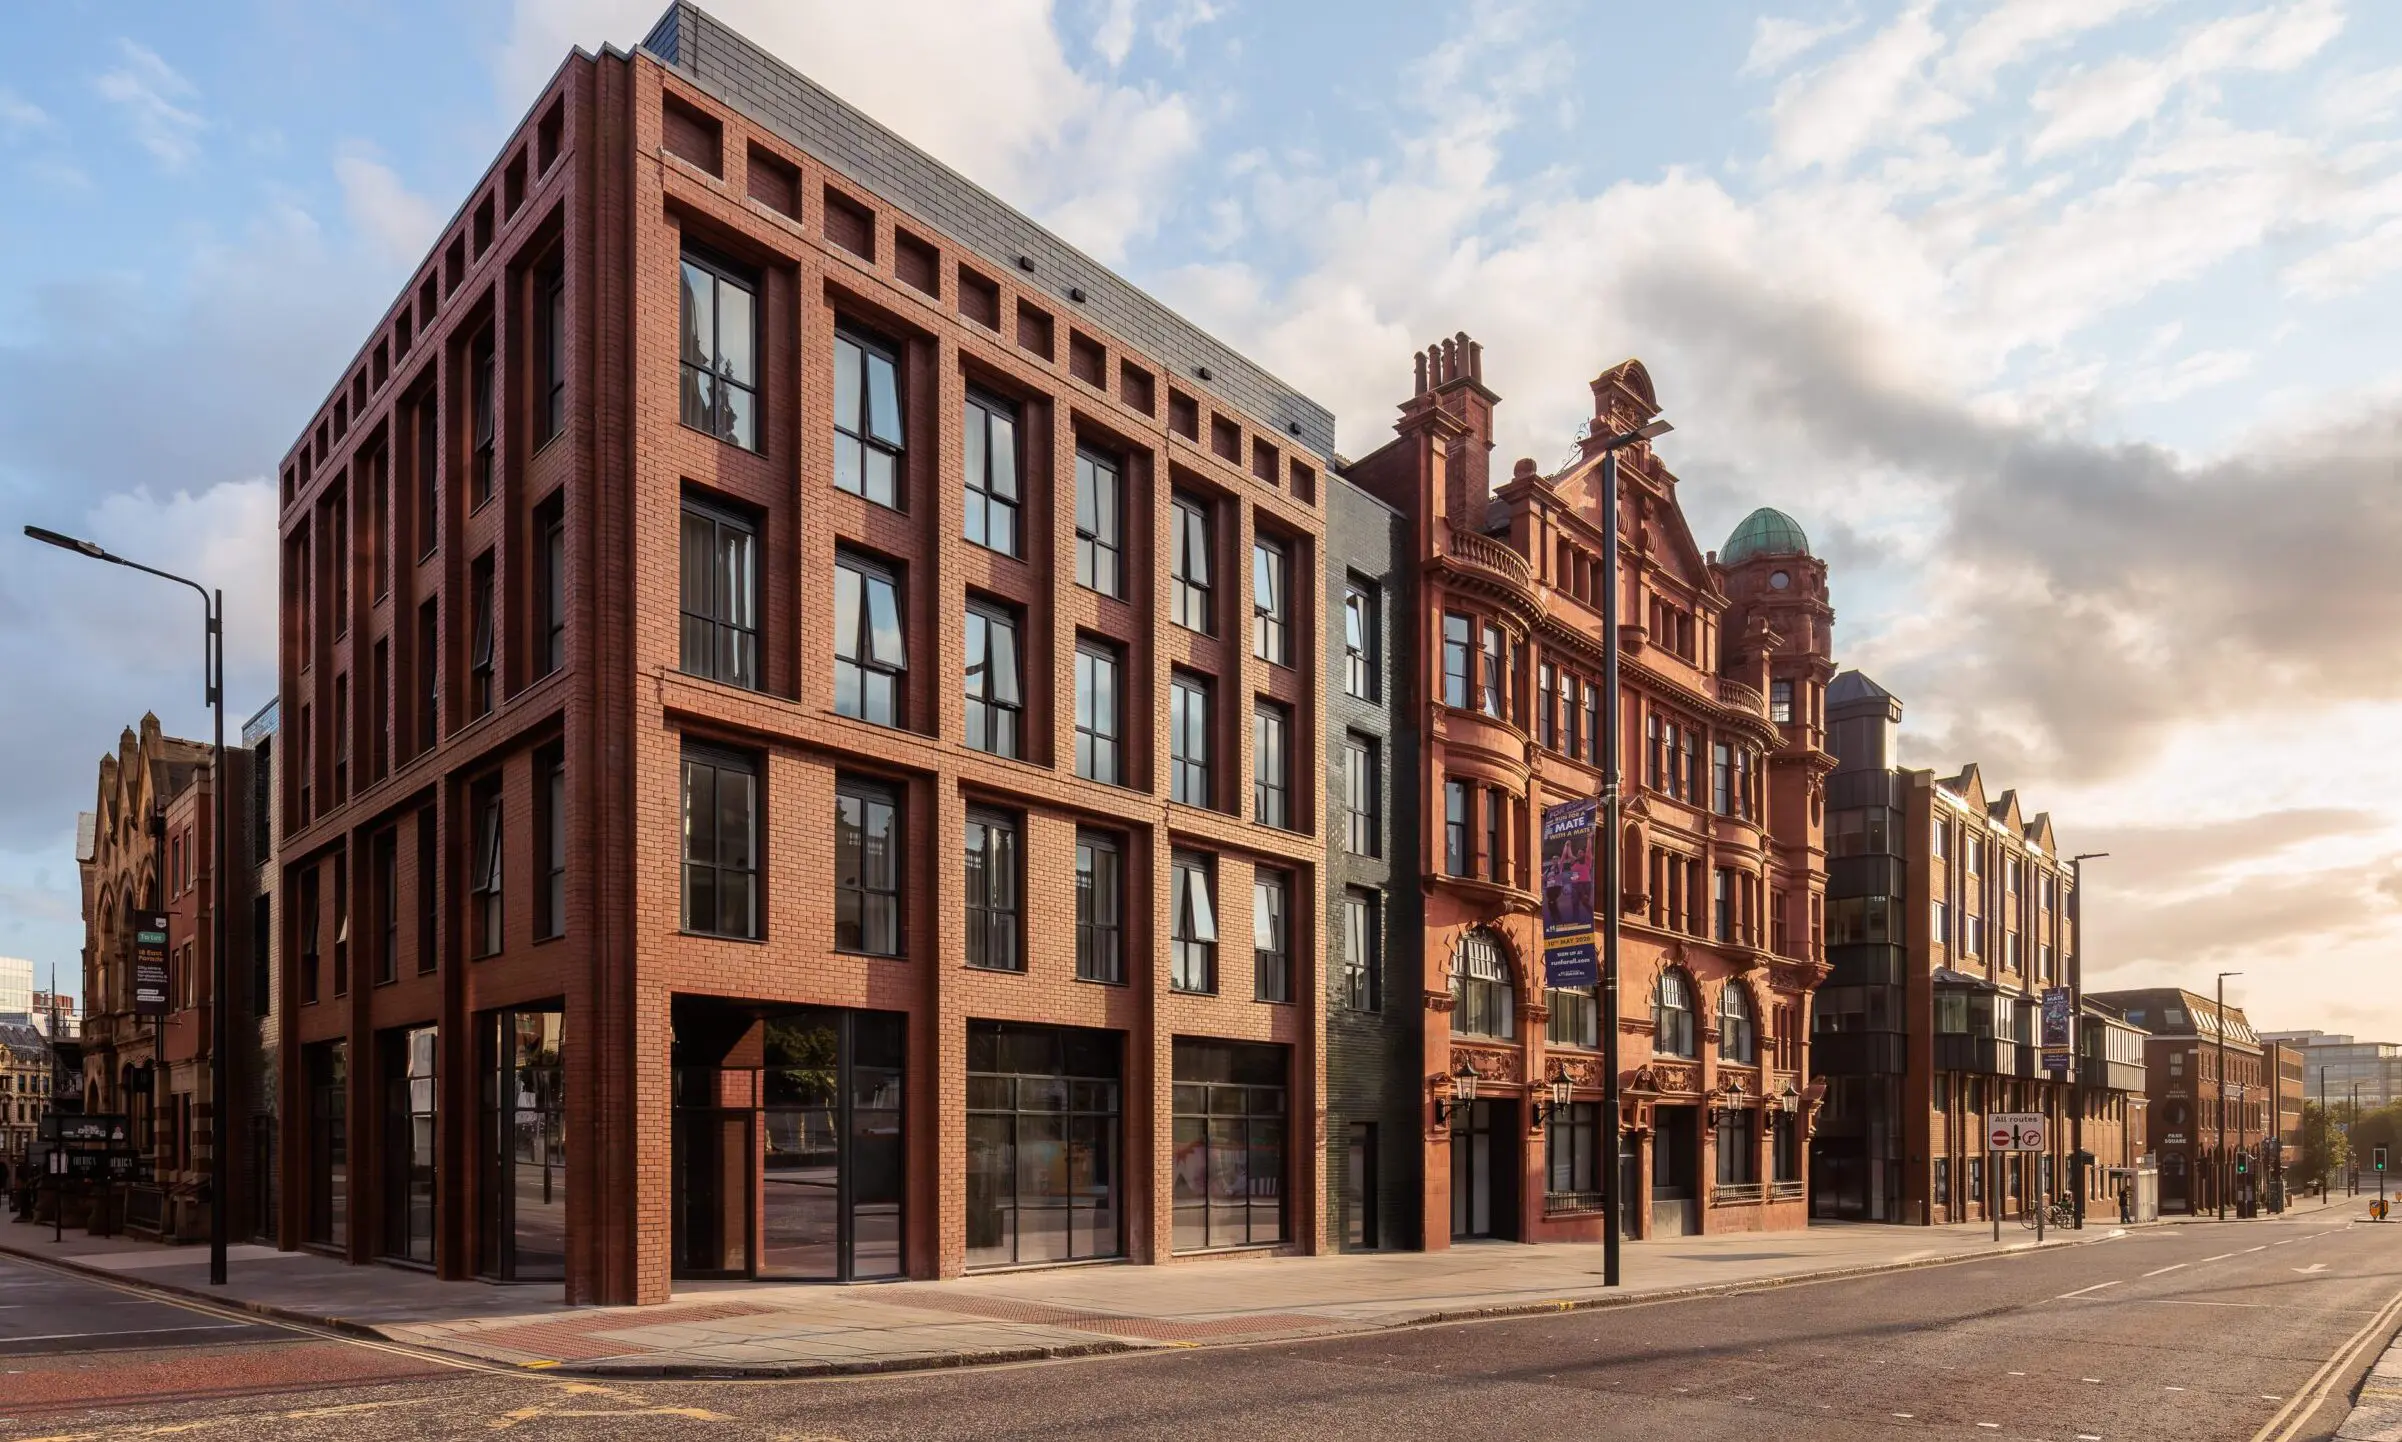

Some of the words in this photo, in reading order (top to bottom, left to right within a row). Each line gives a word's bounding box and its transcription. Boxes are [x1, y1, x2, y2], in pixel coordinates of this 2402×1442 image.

[1555, 816, 1584, 833] MATE
[1550, 832, 1566, 840] WITH
[1560, 937, 1574, 945] MAY
[1995, 1115, 2007, 1123] All
